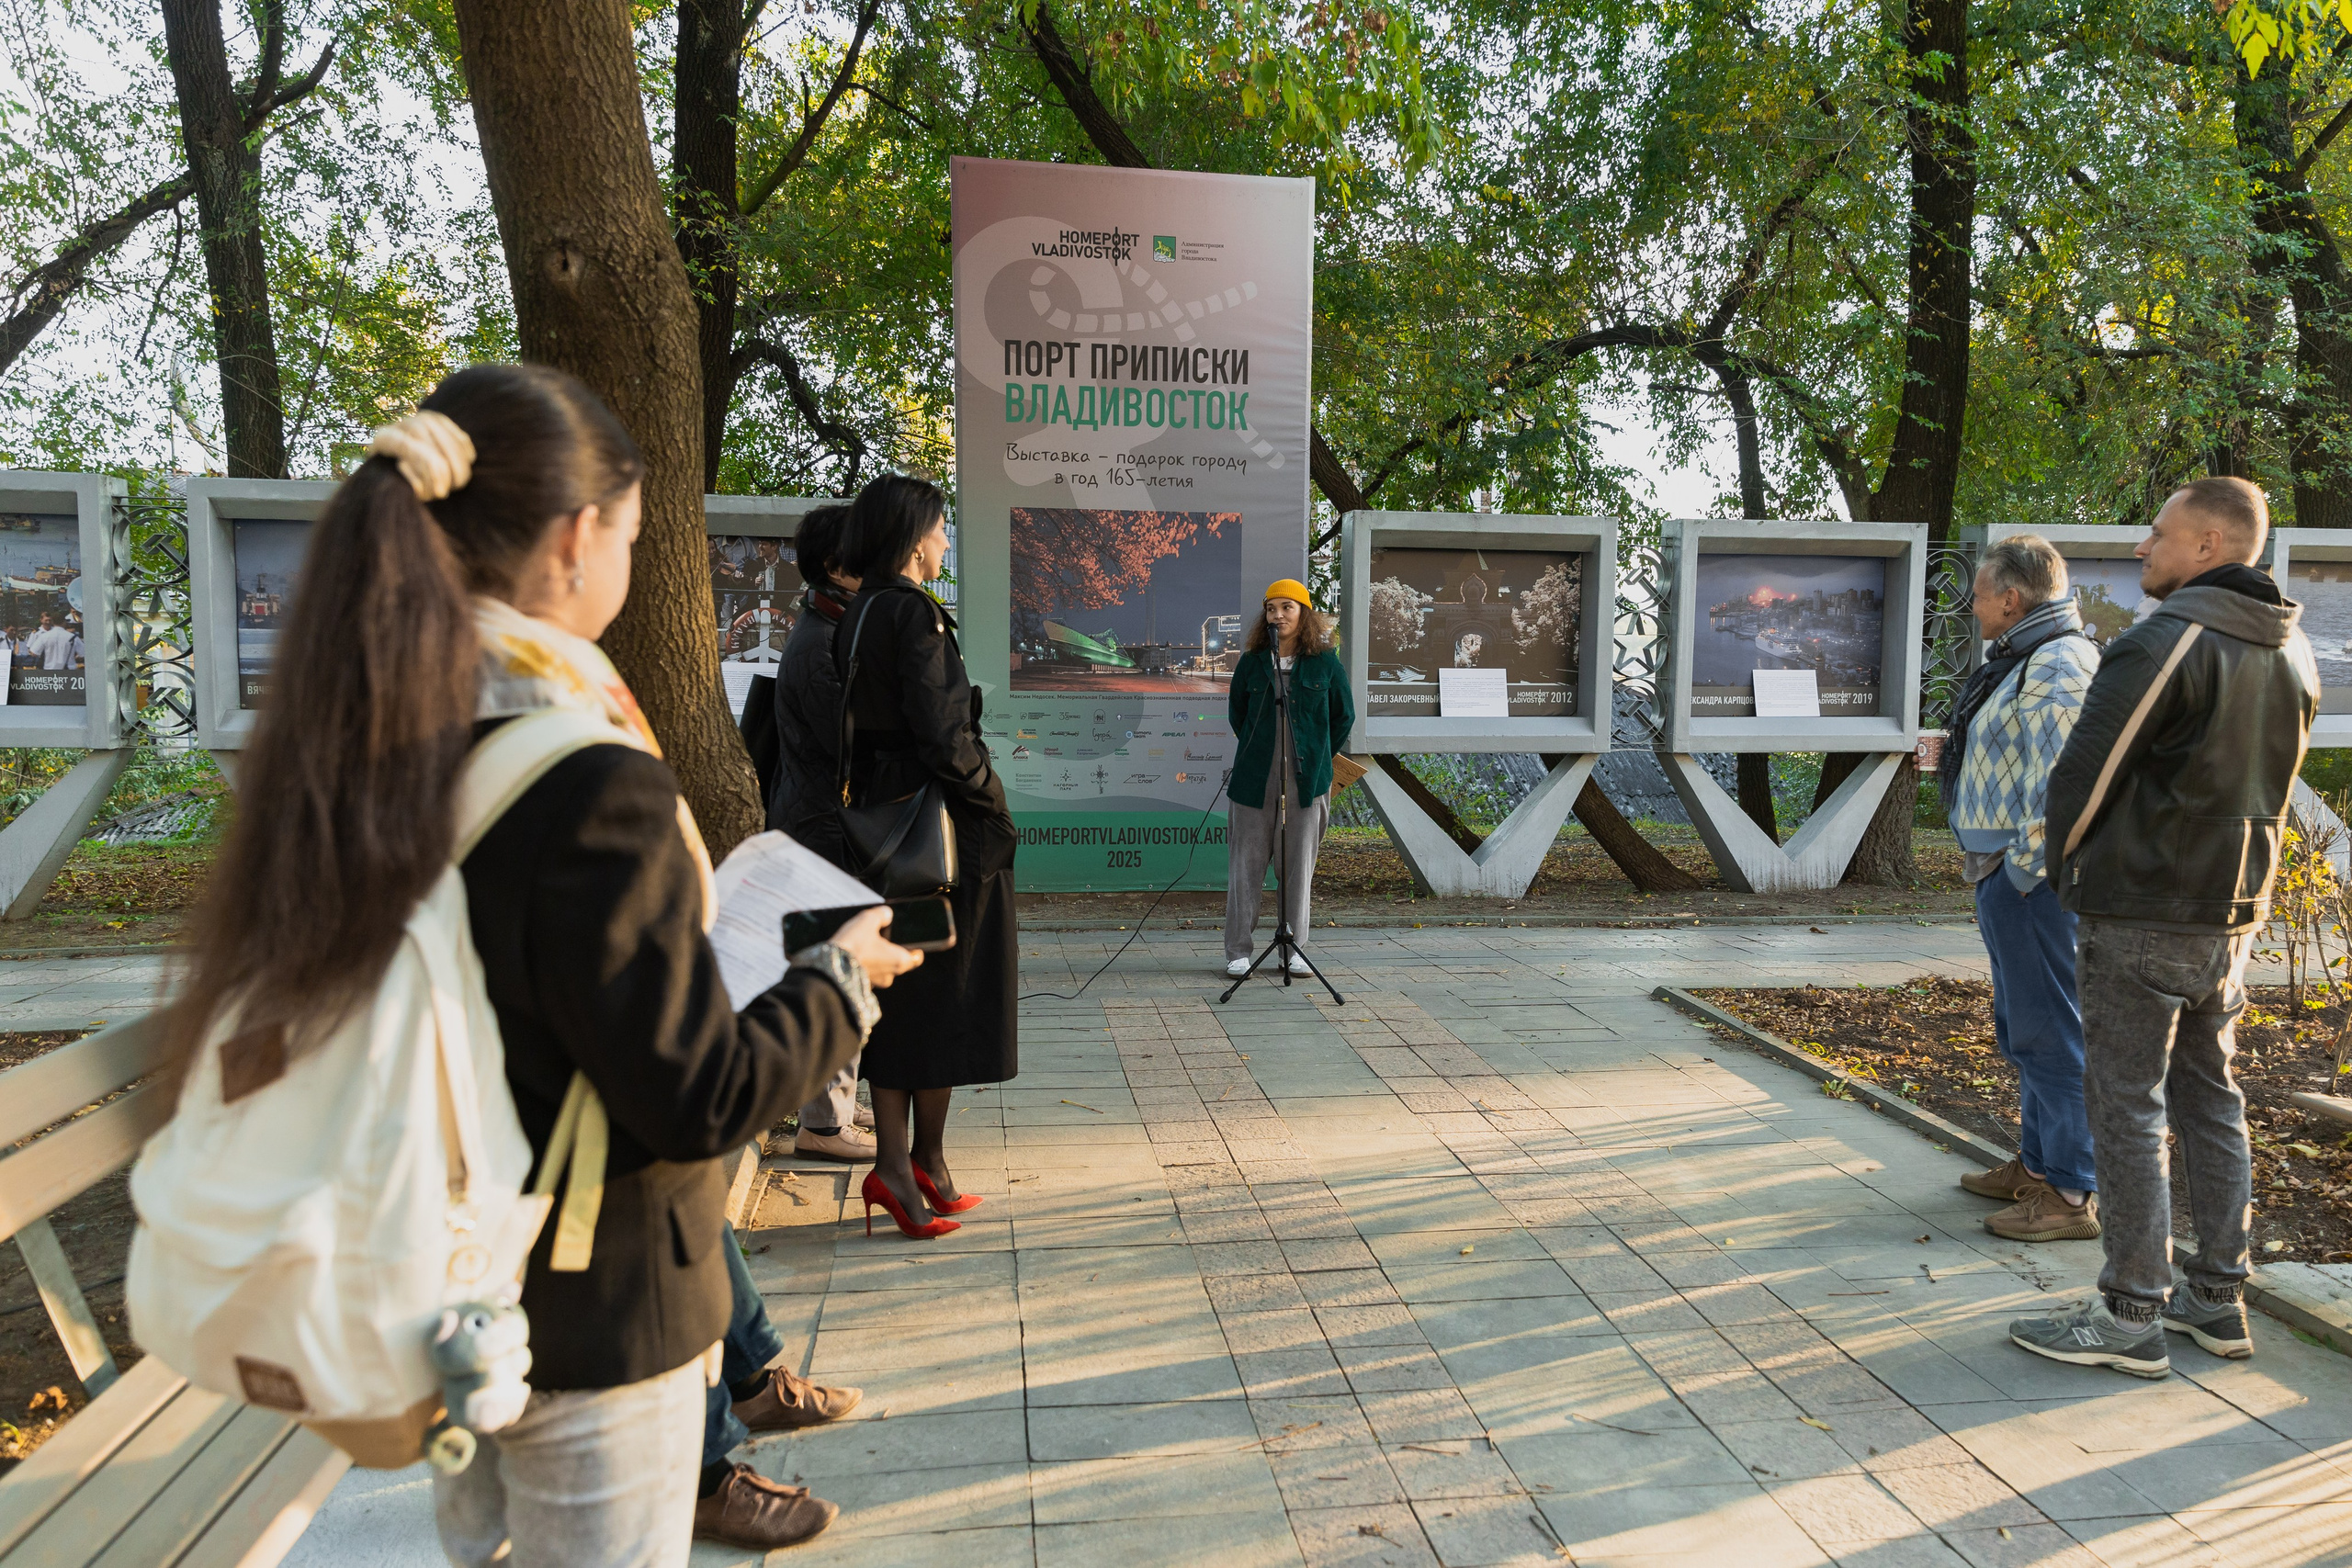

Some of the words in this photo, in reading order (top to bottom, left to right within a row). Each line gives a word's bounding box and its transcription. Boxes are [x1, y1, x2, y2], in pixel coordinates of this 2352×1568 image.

[1059, 230, 1139, 247] HOMEPORT
[1032, 243, 1132, 261] VLADIVOSTOK
[1004, 340, 1080, 378] ПОРТ
[1091, 344, 1249, 385] ПРИПИСКИ
[1005, 383, 1249, 431] ВЛАДИВОСТОК
[1006, 443, 1091, 463] Выставка
[1116, 453, 1185, 467] подарок
[1193, 456, 1248, 475] городу
[1055, 473, 1064, 484] в
[1071, 473, 1099, 488] год
[1106, 468, 1193, 488] 165-летия
[1551, 692, 1572, 703] 2012
[1852, 693, 1873, 704] 2019
[1107, 851, 1142, 868] 2025
